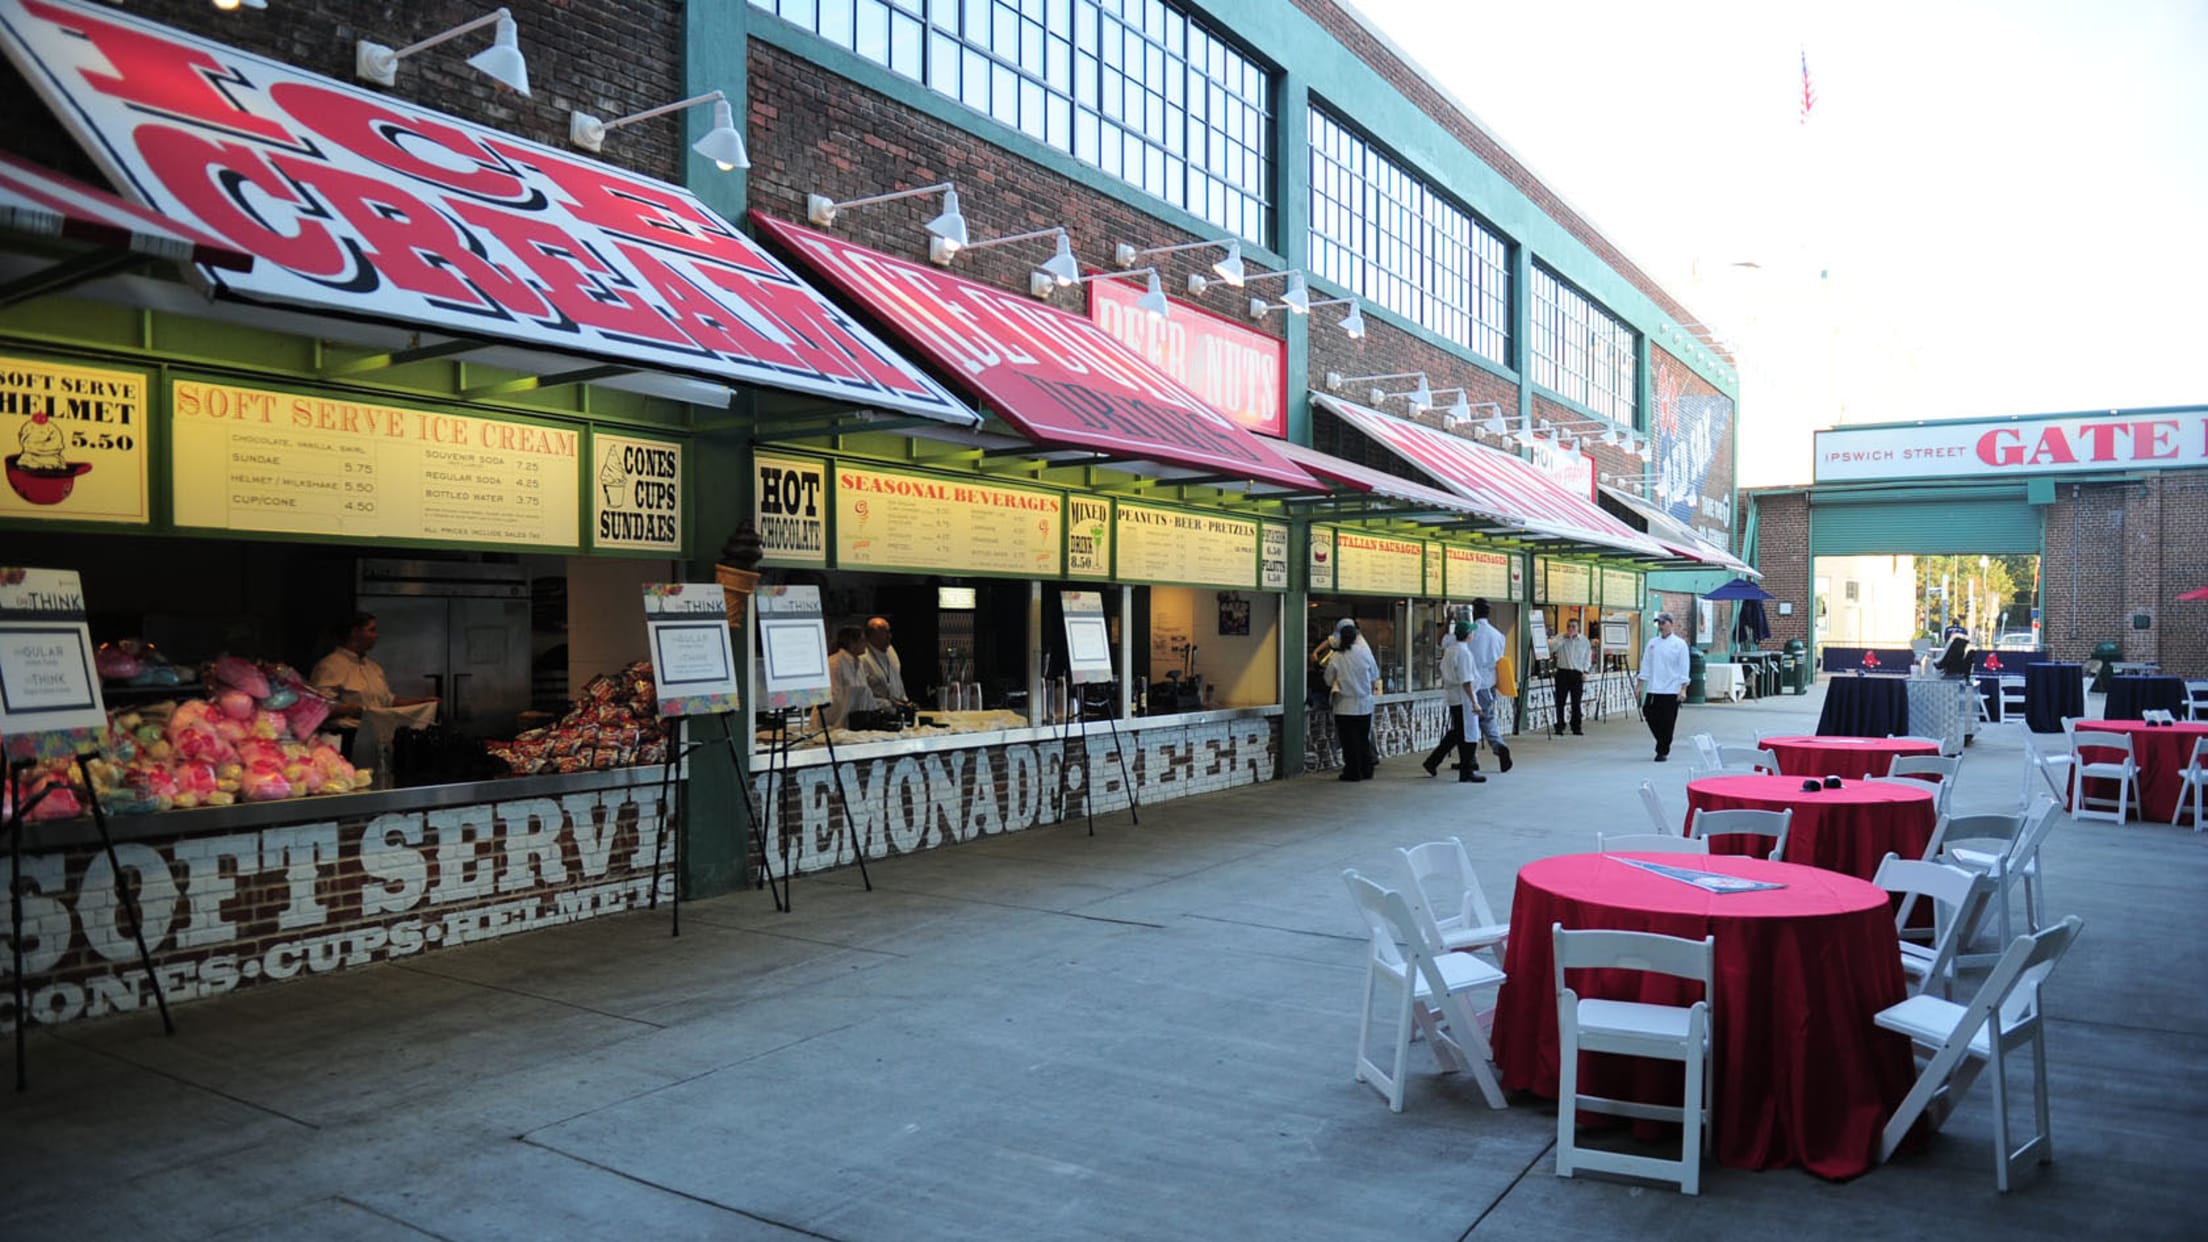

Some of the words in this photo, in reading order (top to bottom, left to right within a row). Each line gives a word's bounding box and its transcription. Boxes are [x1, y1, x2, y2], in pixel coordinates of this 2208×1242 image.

[17, 0, 796, 284] ICE
[133, 123, 945, 403] CREAM
[806, 240, 1039, 376] ICE
[959, 286, 1254, 432] COLD
[61, 377, 136, 399] SERVE
[1203, 334, 1276, 421] NUTS
[0, 391, 135, 425] HELMET
[176, 381, 278, 424] SOFT
[292, 401, 404, 437] SERVE
[416, 413, 468, 445] ICE
[480, 421, 576, 457] CREAM
[1014, 371, 1262, 463] DRINKS
[71, 432, 134, 451] 5.50
[424, 449, 475, 461] SOUVENIR
[479, 455, 505, 465] SODA
[1825, 450, 1894, 462] IPSWICH
[1904, 446, 1967, 460] STREET
[1976, 420, 2180, 467] GATE
[232, 452, 281, 466] SUNDAE
[344, 462, 373, 475] 5.75
[624, 445, 676, 478] CONES
[283, 477, 340, 490] MILKSHAKE
[344, 481, 375, 494] 5.50
[425, 471, 472, 483] REGULAR
[476, 475, 502, 485] SODA
[760, 466, 820, 517] HOT
[841, 473, 950, 502] SEASONAL
[953, 488, 1060, 514] BEVERAGES
[232, 494, 297, 507] CUP/CONE
[344, 501, 375, 513] 4.50
[425, 489, 469, 501] BOTTLED
[473, 494, 504, 503] WATER
[634, 479, 676, 510] CUPS
[600, 510, 676, 543] SUNDAES
[1070, 501, 1107, 525] MIXED
[1117, 509, 1167, 526] PEANUTS
[1174, 516, 1201, 531] BEER
[1208, 521, 1255, 536] PRETZELS
[761, 517, 821, 551] CHOCOLATE
[1070, 535, 1093, 554] DRINK
[1338, 535, 1377, 551] ITALIAN
[1378, 541, 1421, 556] SAUSAGES
[1070, 556, 1092, 569] 8.50
[1473, 552, 1507, 565] SAUSAGES
[684, 600, 725, 612] THINK
[753, 737, 1066, 881] LEMONADE
[1084, 717, 1276, 816] BEER
[0, 820, 340, 977] SOFT
[360, 782, 676, 917] SERVE
[262, 918, 424, 981] CUPS
[442, 872, 676, 946] HELMETS
